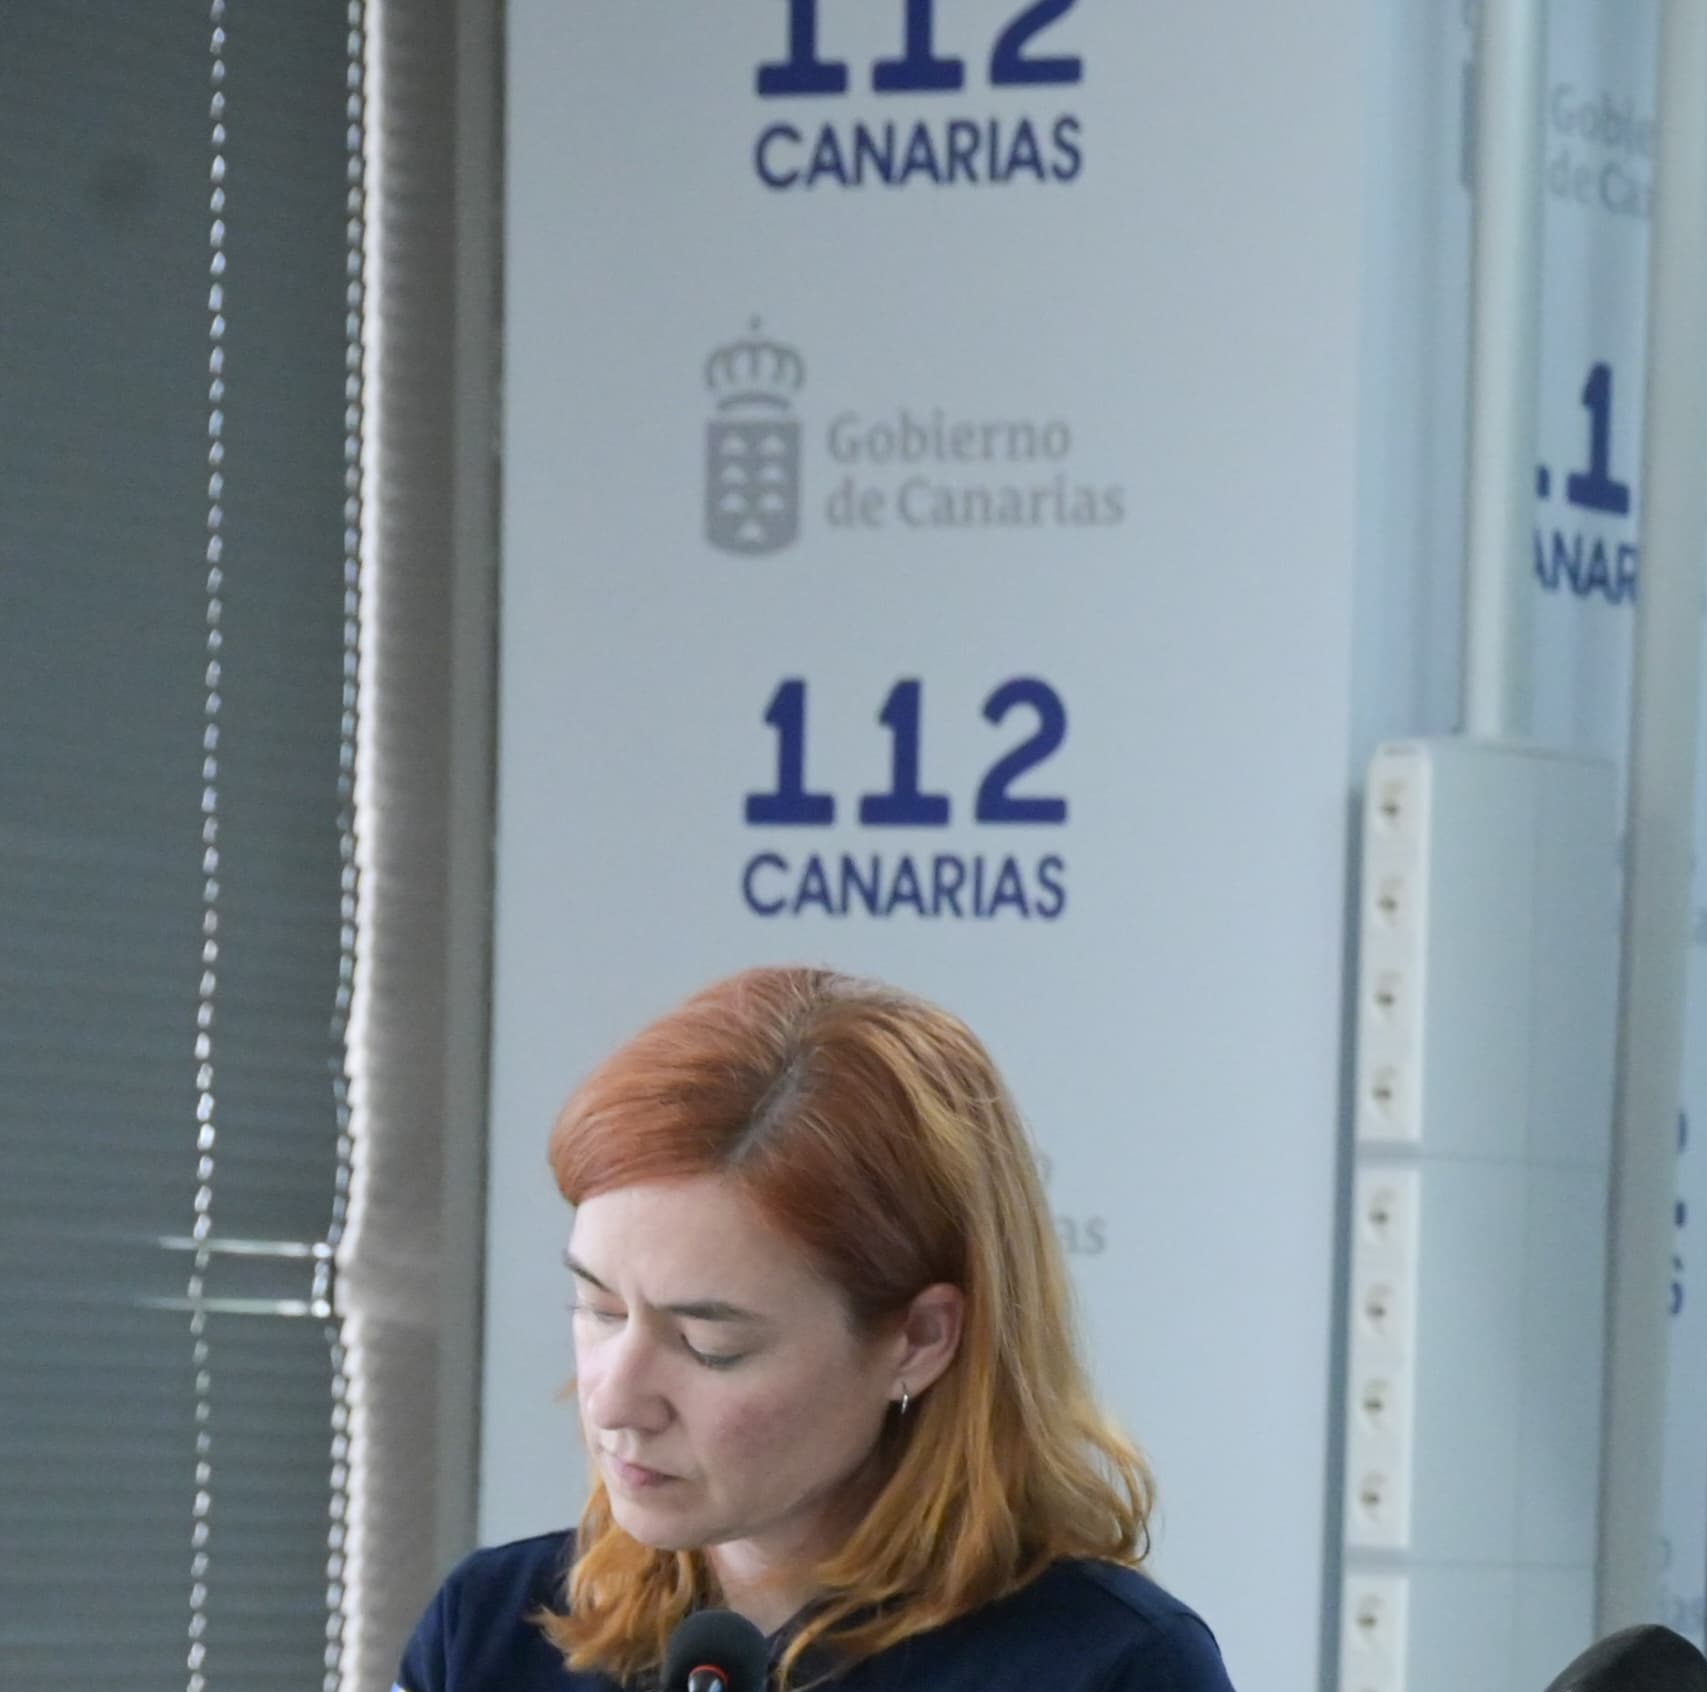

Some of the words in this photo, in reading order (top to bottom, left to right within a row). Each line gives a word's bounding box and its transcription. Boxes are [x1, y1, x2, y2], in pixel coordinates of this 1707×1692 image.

[754, 0, 1083, 97] 112
[754, 116, 1083, 190] CANARIAS
[826, 412, 1072, 462] Gobierno
[825, 478, 886, 527] de
[899, 476, 1126, 527] Canarias
[744, 676, 1068, 826] 112
[742, 852, 1068, 920] CANARIAS
